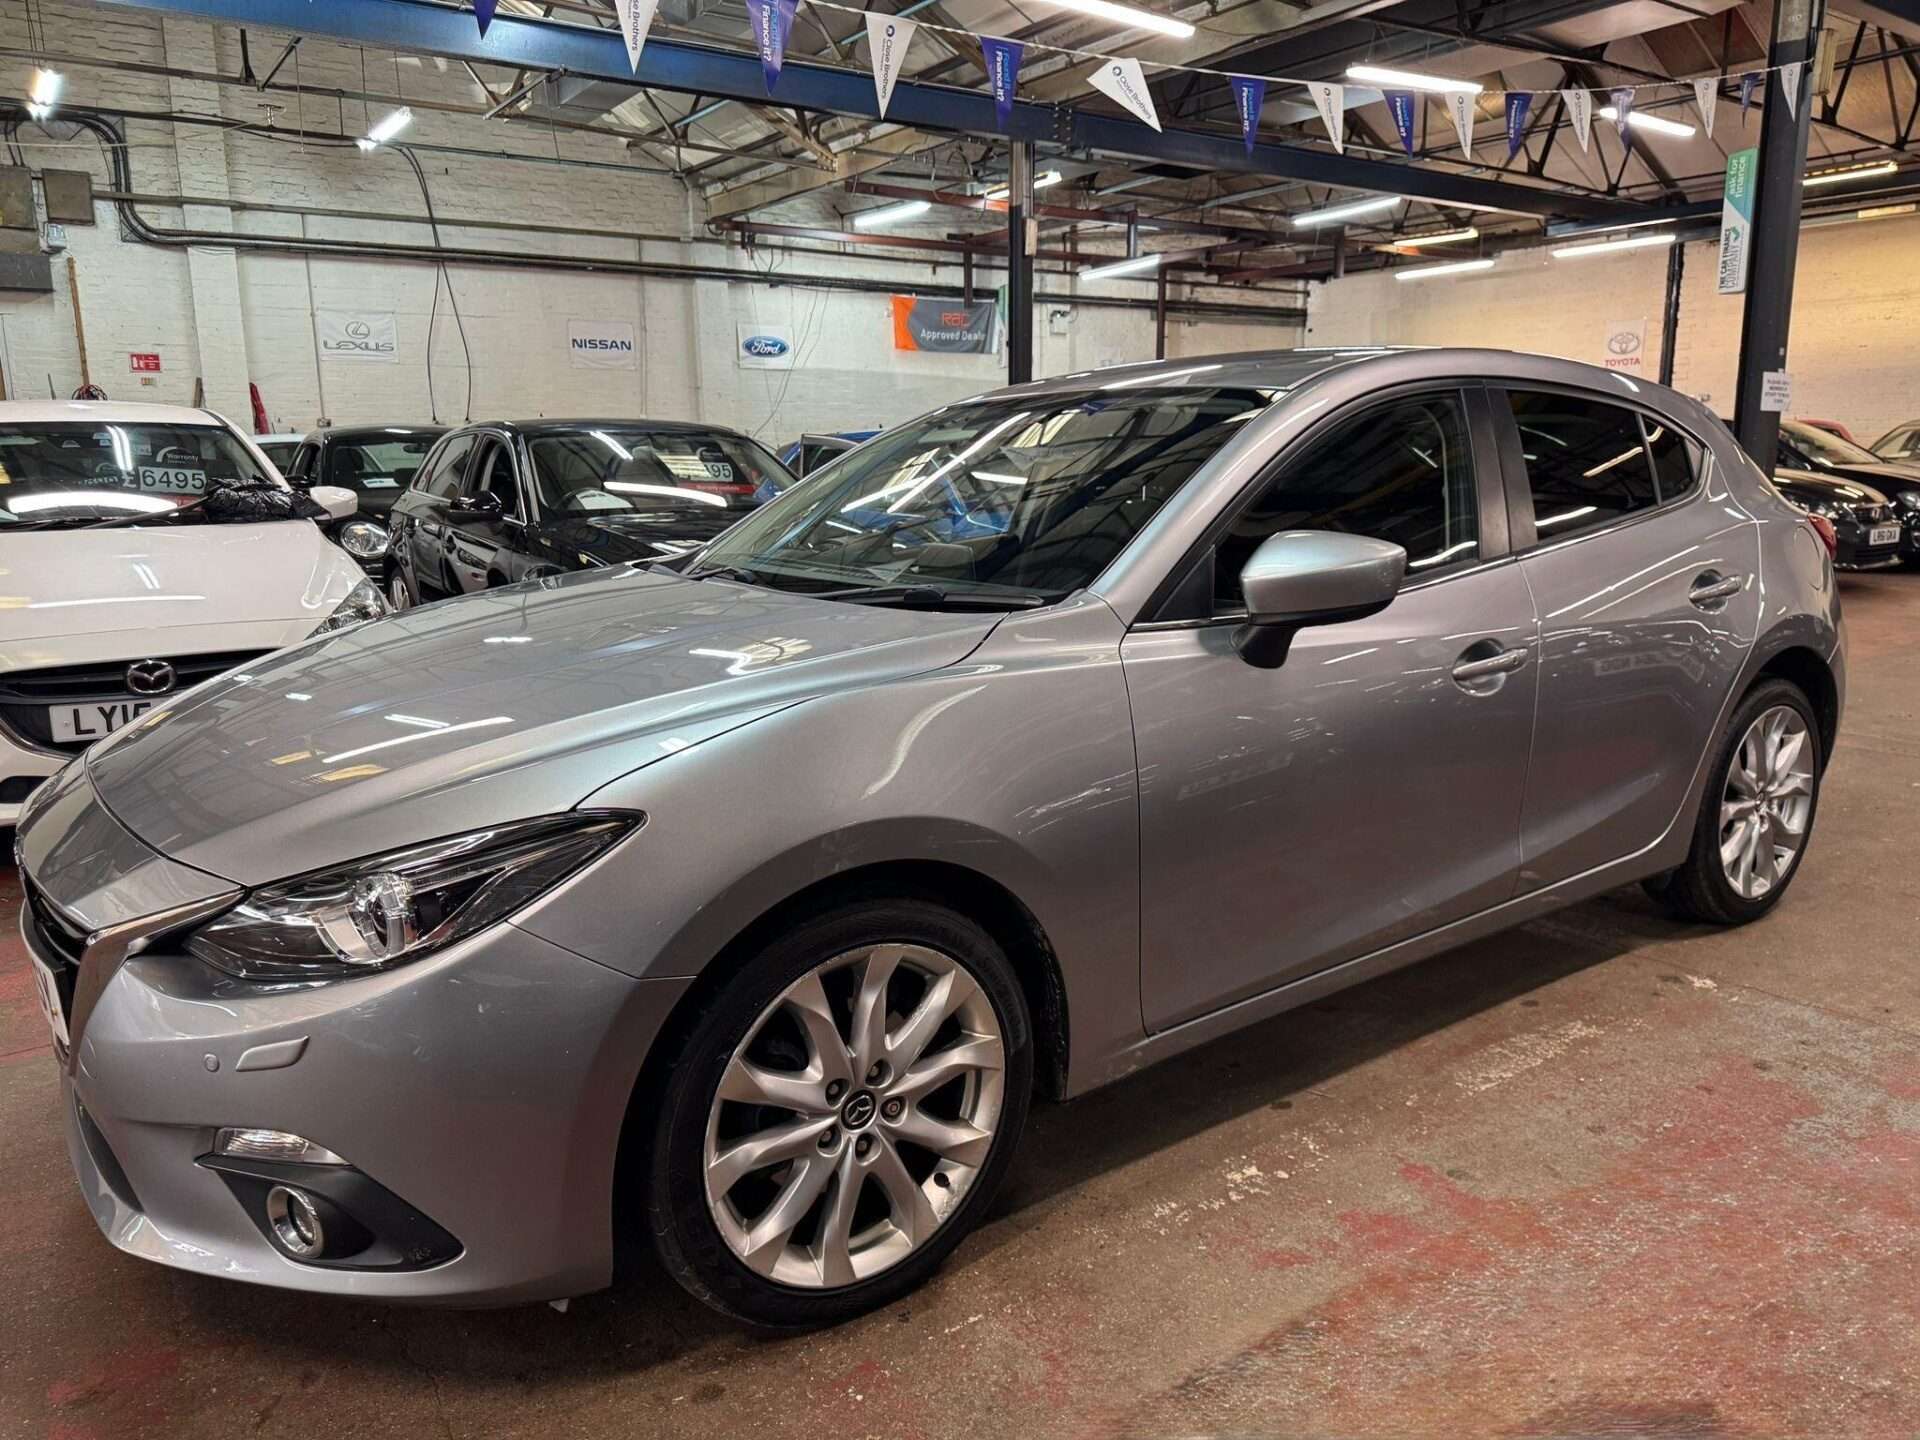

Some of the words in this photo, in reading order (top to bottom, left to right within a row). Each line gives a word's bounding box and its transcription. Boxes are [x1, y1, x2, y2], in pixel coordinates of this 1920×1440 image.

[632, 11, 641, 51] Brothers
[762, 5, 771, 46] Finance
[763, 47, 772, 61] it?
[884, 39, 893, 63] Close
[881, 64, 890, 99] Brothers
[997, 88, 1005, 102] it?
[1120, 75, 1134, 95] Close
[1132, 93, 1152, 119] Brothers
[1730, 158, 1739, 177] for
[1735, 155, 1746, 198] finance
[1729, 177, 1737, 195] ask
[1722, 228, 1732, 258] FINANCE
[1720, 259, 1728, 273] CAR
[920, 328, 960, 341] Approved
[323, 340, 394, 352] LEXUS
[571, 338, 632, 351] NISSAN
[751, 339, 781, 354] Ford
[1605, 357, 1641, 367] TOYOTA
[142, 470, 206, 491] 6495
